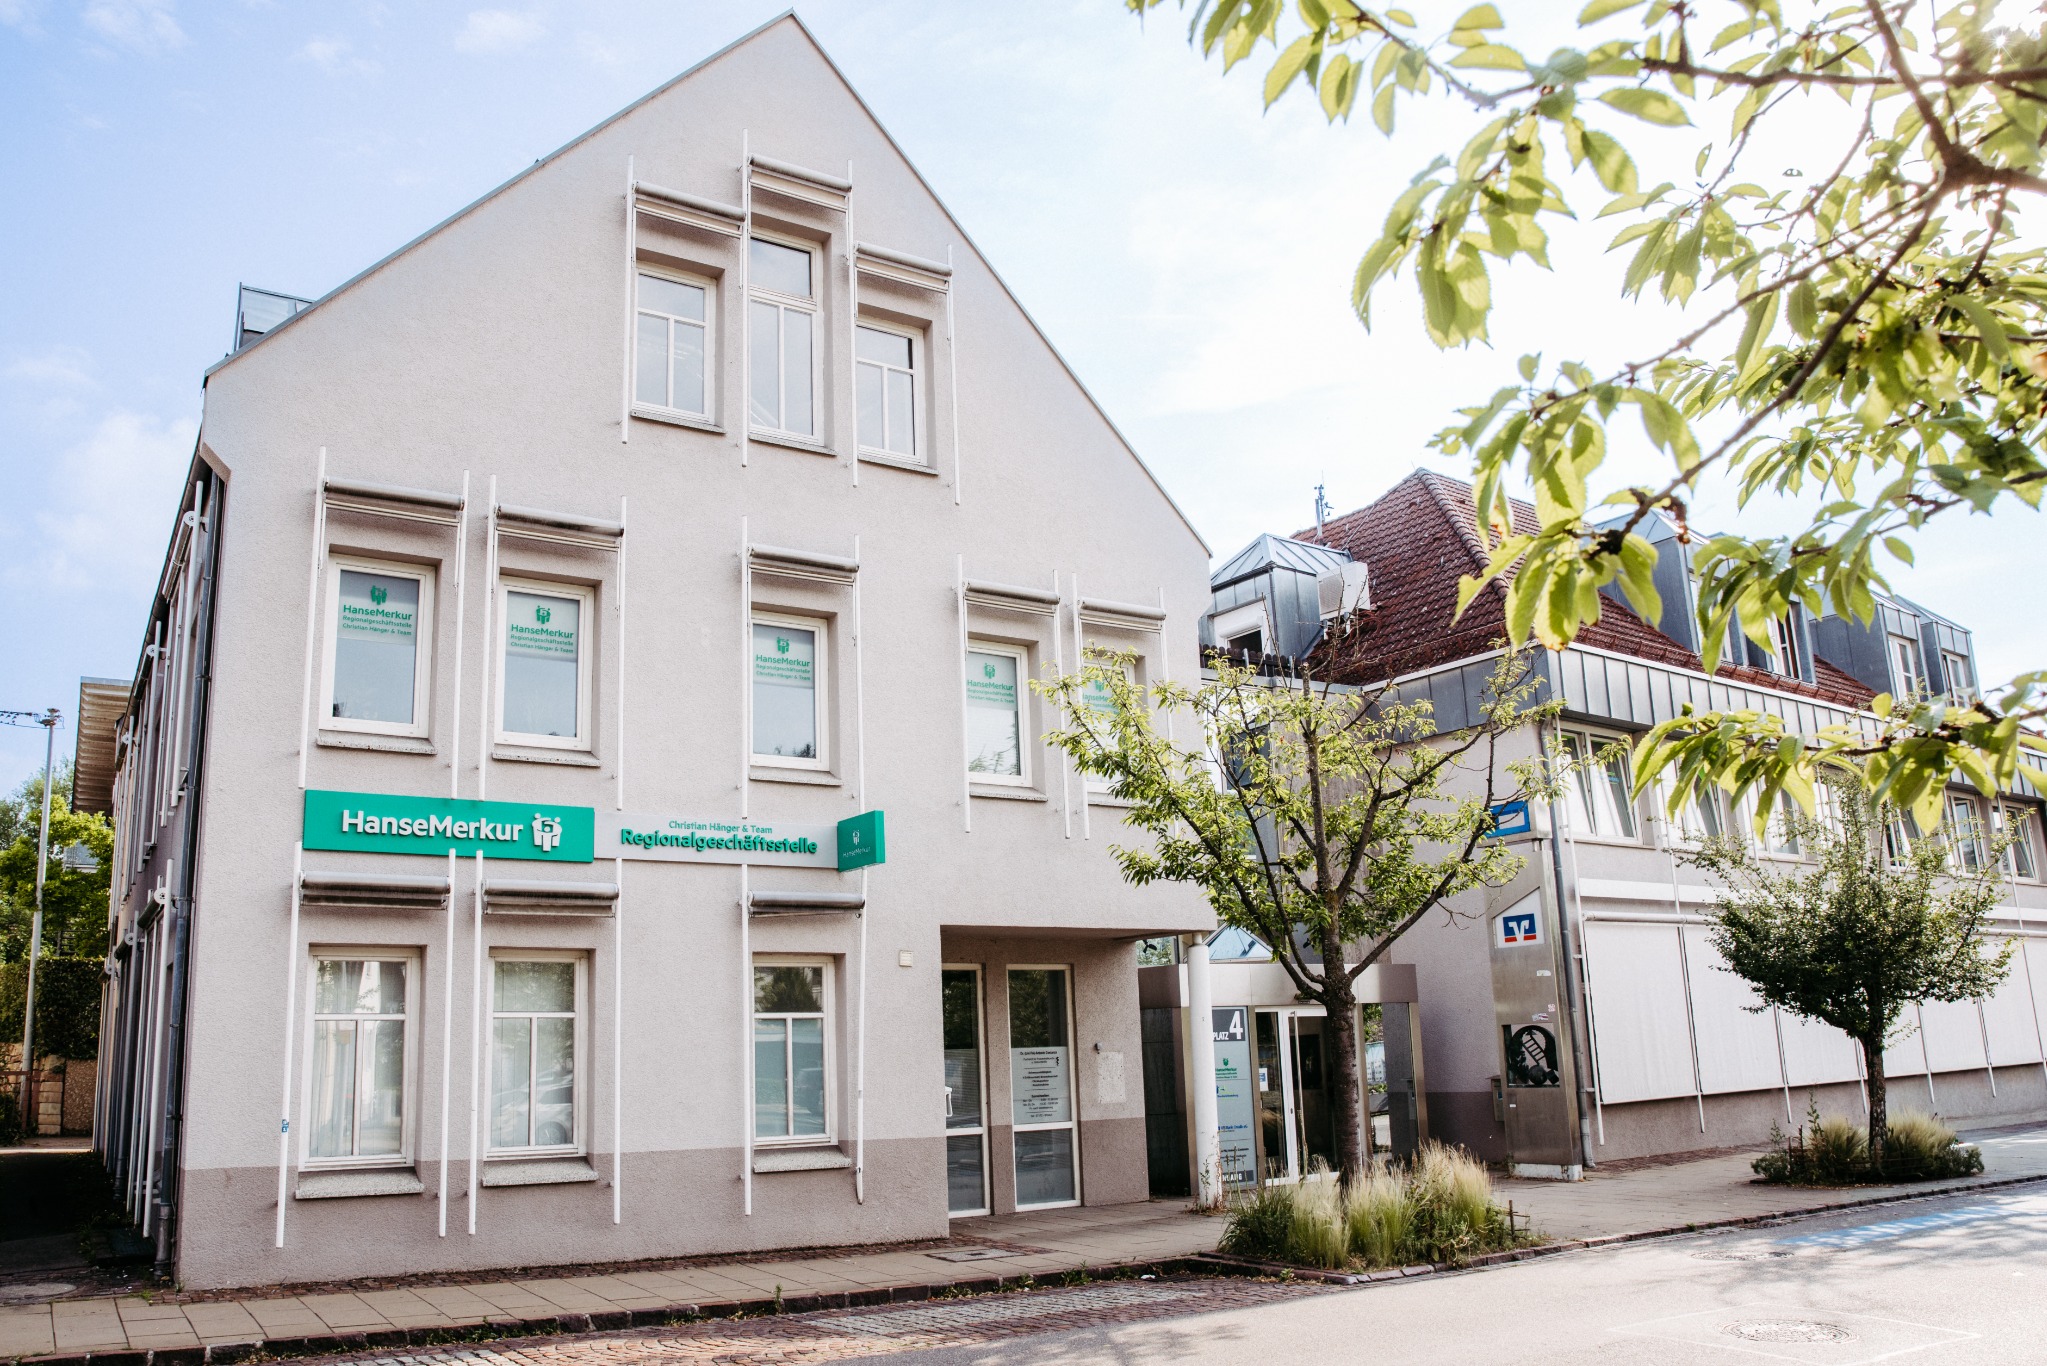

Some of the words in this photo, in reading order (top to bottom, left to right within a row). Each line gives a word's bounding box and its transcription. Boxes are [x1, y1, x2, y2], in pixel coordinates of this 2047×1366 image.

[343, 604, 412, 620] HanseMerkur
[343, 615, 412, 628] Regionalgeschäftsstelle
[343, 622, 368, 631] Christian
[511, 624, 574, 639] HanseMerkur
[511, 634, 573, 646] Regionalgeschäftsstelle
[511, 641, 533, 649] Christian
[756, 654, 811, 667] HanseMerkur
[967, 680, 1014, 691] HanseMerkur
[341, 809, 524, 842] HanseMerkur
[668, 820, 707, 831] Christian
[709, 822, 740, 834] Hänger
[742, 824, 749, 832] &
[750, 825, 773, 834] Team
[621, 828, 818, 855] Regionalgeschäftsstelle
[842, 846, 871, 858] HanseMerkur
[1229, 1010, 1244, 1040] 4
